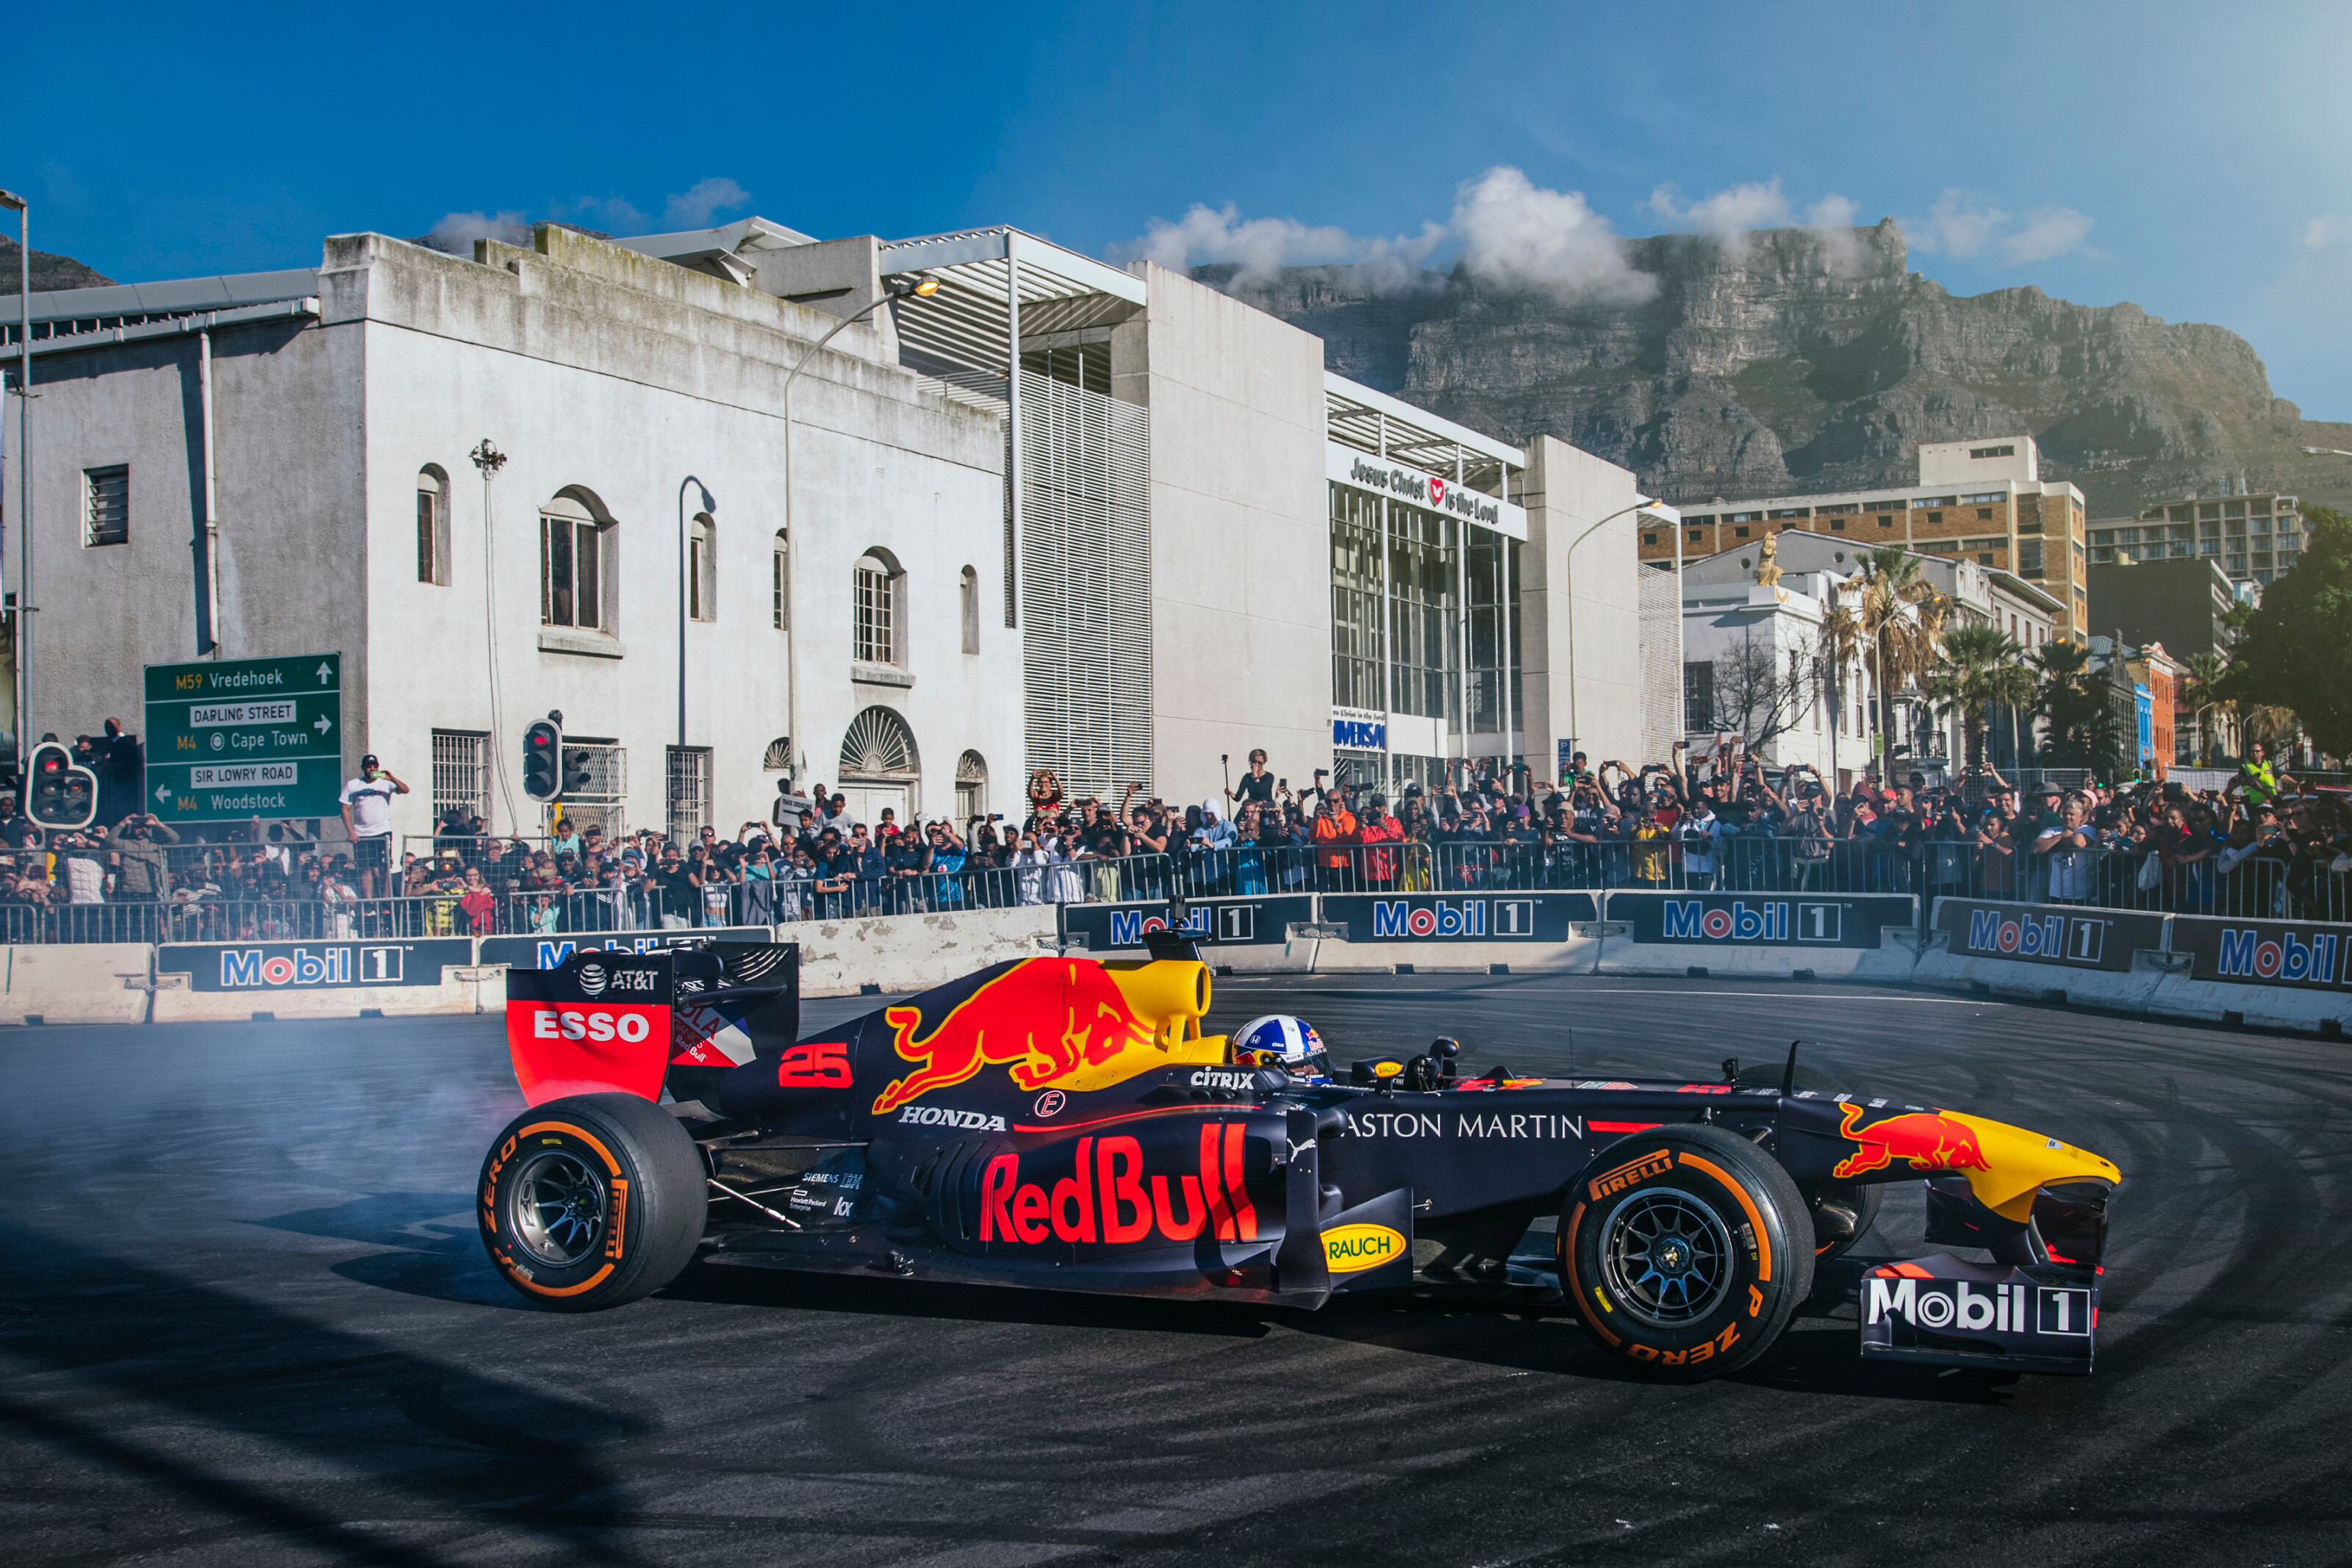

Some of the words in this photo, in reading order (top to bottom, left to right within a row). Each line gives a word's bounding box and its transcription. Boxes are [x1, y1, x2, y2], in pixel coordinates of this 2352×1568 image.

[1351, 457, 1388, 487] Jesus
[1391, 470, 1425, 500] Christ
[1446, 487, 1455, 509] is
[1457, 492, 1473, 516] the
[1474, 498, 1498, 524] Lord
[176, 674, 203, 690] M59
[209, 669, 283, 688] Vredehoek
[194, 708, 243, 722] DARLING
[248, 705, 292, 720] STREET
[176, 736, 196, 750] M4
[231, 733, 265, 751] Cape
[272, 730, 308, 747] Town
[196, 769, 213, 783] SIR
[218, 768, 257, 783] LOWRY
[262, 766, 293, 780] ROAD
[177, 796, 197, 810] M4
[211, 793, 285, 810] Woodstock
[794, 802, 812, 810] CROSSING
[1374, 899, 1485, 937] Mobil
[1663, 900, 1788, 941] Mobil
[1968, 909, 2064, 958] Mobil
[221, 947, 351, 987] Mobil
[2217, 929, 2337, 982] Mobil
[611, 970, 658, 990] AT&T
[534, 1010, 649, 1043] ESSO
[778, 1043, 852, 1088] 25
[898, 1106, 1006, 1132] HONDA
[1341, 1113, 1441, 1138] ASTON
[1458, 1114, 1582, 1140] MARTIN
[483, 1134, 516, 1234] ZERO
[802, 1172, 839, 1184] SIEMENS
[839, 1173, 864, 1190] IBM
[1588, 1148, 1674, 1201] PIRELLI
[789, 1203, 811, 1212] Enterprise
[790, 1196, 808, 1205] Hewlett
[833, 1196, 853, 1217] kx
[605, 1179, 628, 1259] PIRELLI
[1329, 1236, 1391, 1259] RAUCH
[1749, 1284, 1763, 1317] P
[1868, 1279, 2024, 1333] Mobil
[1627, 1321, 1740, 1365] ZERO
